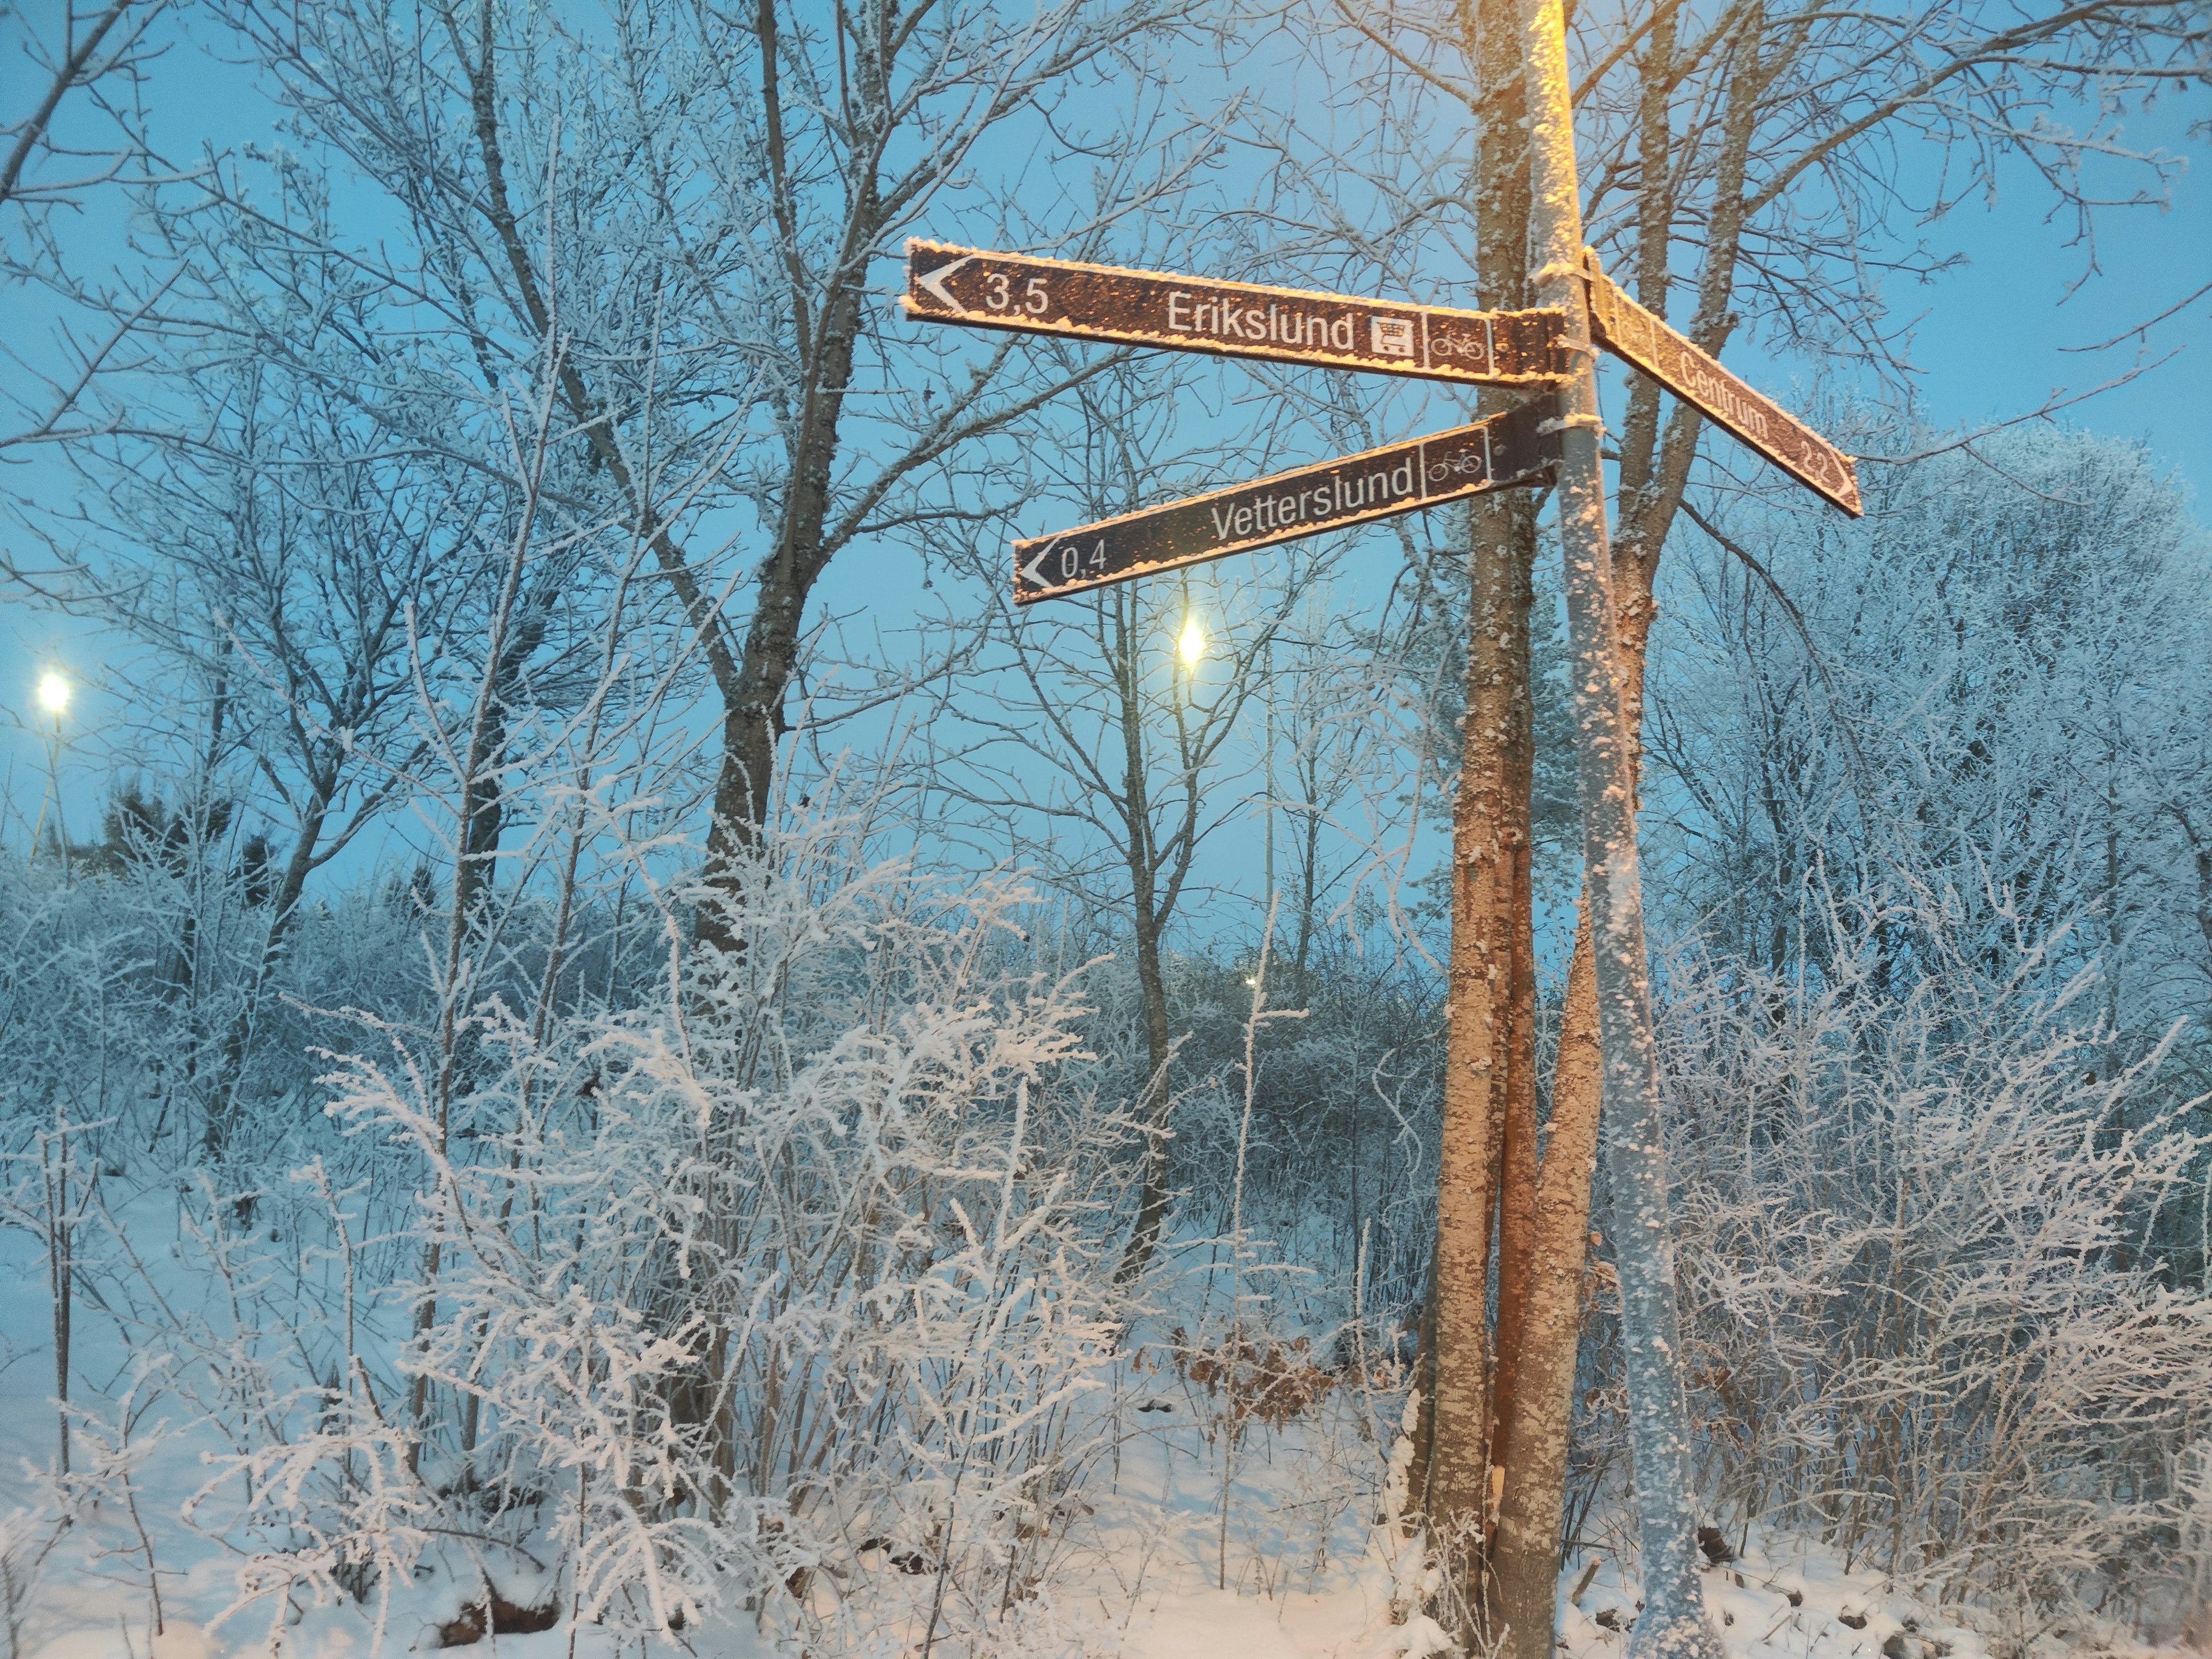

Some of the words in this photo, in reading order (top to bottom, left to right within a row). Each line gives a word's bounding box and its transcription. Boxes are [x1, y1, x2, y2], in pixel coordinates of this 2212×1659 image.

[985, 273, 1049, 315] 3,5
[1167, 293, 1354, 350] Erikslund
[1680, 351, 1769, 440] Centrum
[1801, 440, 1831, 483] 2,2
[1060, 539, 1107, 578] 0,4
[1211, 457, 1414, 540] Vetterslund
